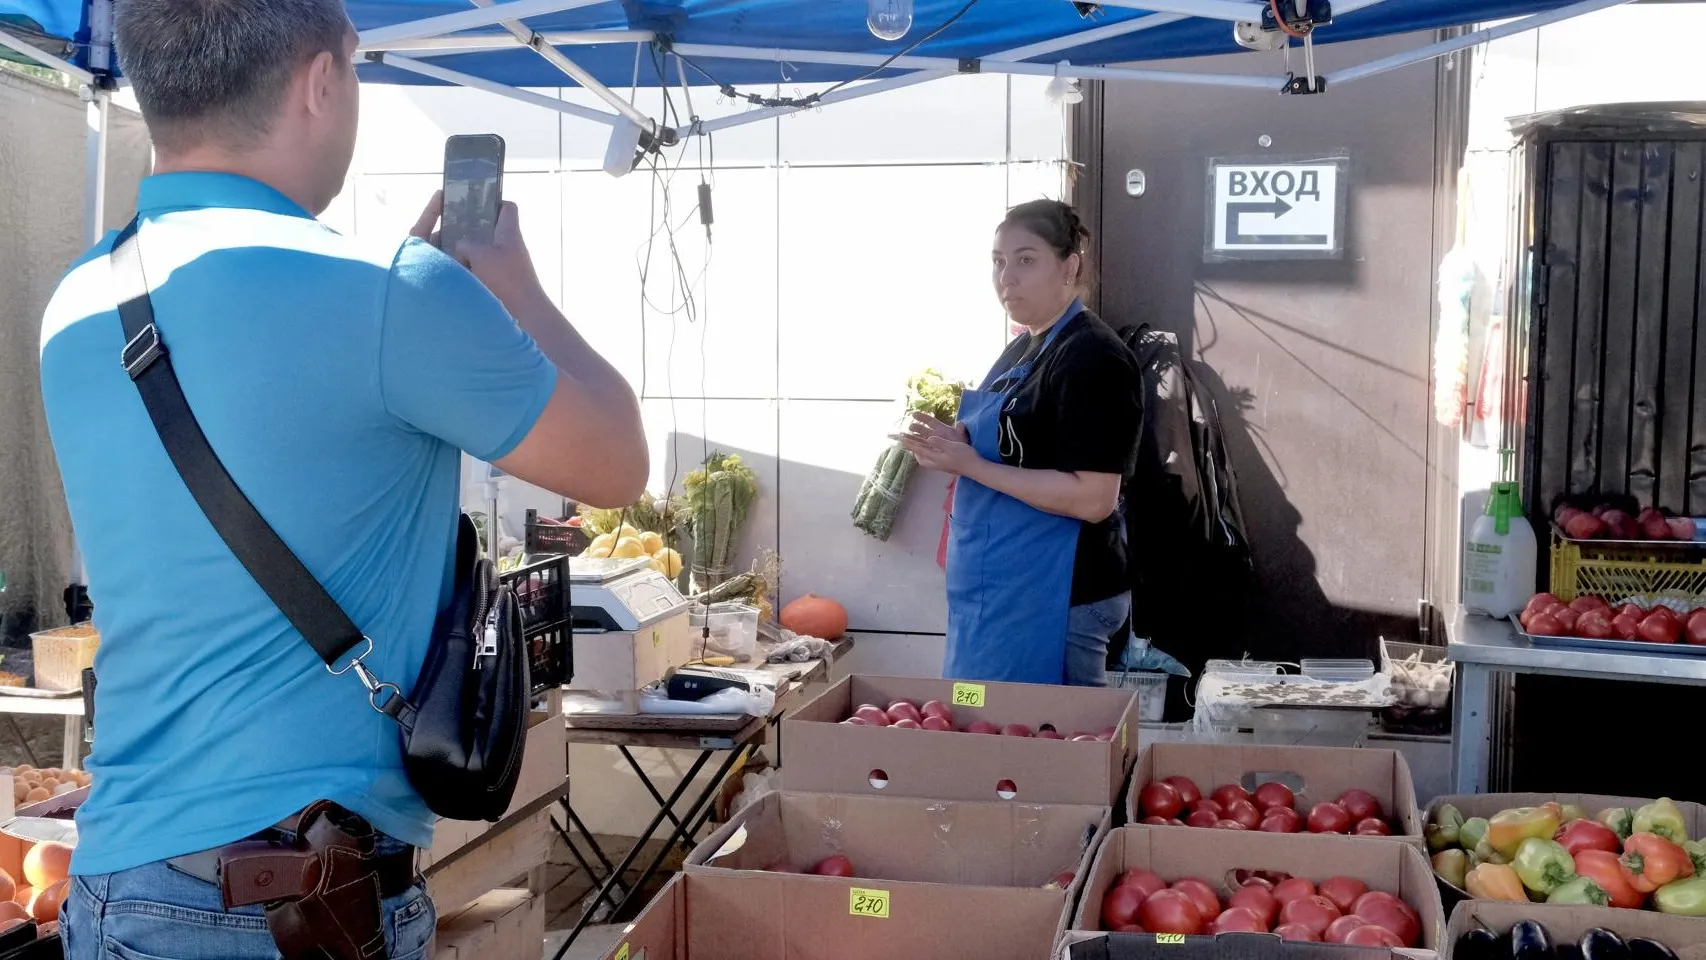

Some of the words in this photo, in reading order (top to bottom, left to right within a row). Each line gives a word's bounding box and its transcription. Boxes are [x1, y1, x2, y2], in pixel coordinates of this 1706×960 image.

[1228, 170, 1320, 202] ВХОД
[956, 690, 979, 705] 270
[854, 896, 884, 913] 270
